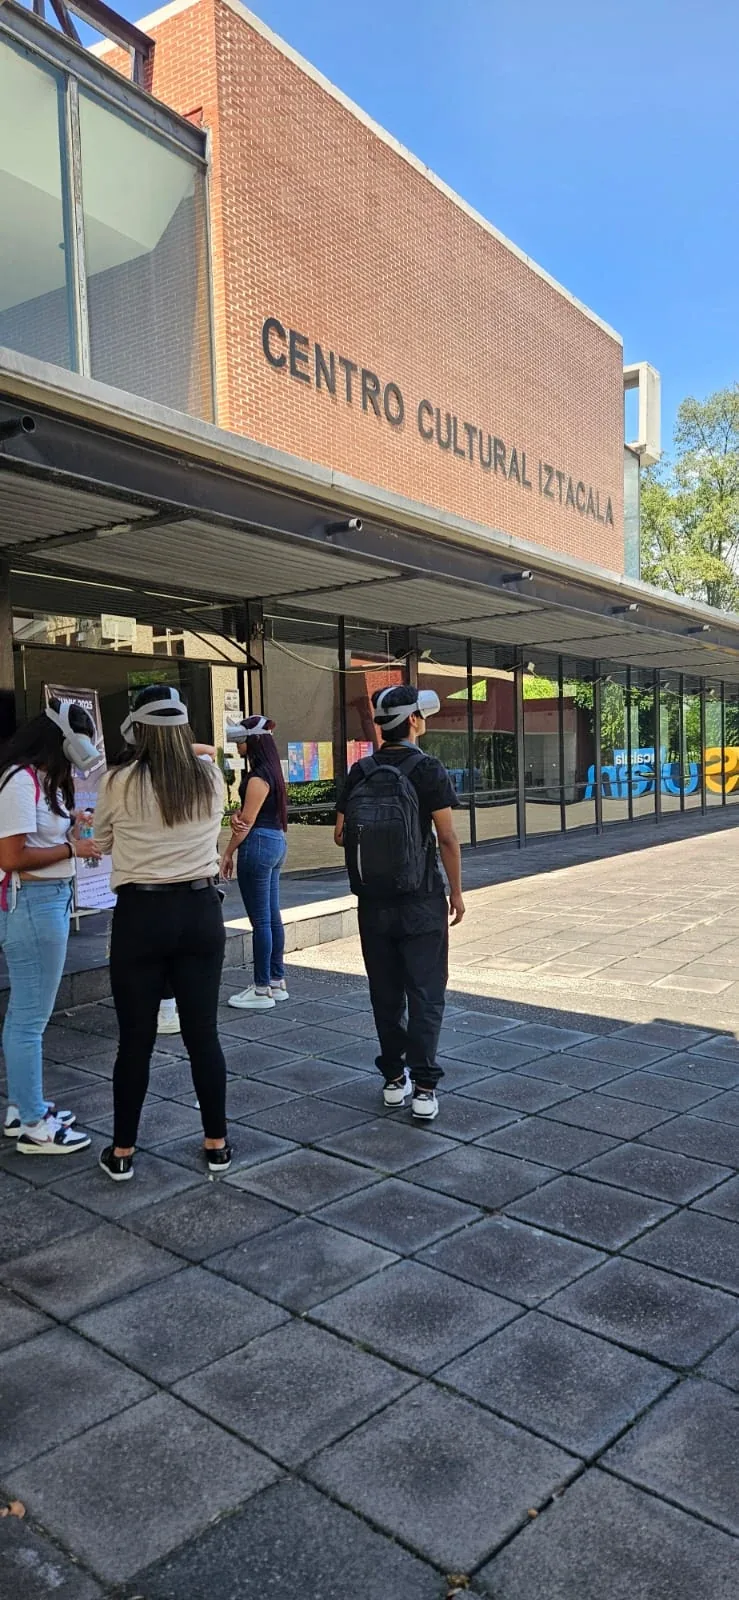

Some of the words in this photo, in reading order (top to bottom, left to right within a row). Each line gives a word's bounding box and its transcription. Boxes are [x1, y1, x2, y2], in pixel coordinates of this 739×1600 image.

[261, 316, 404, 426] CENTRO
[417, 399, 532, 490] CULTURAL
[538, 459, 615, 528] IZTACALA
